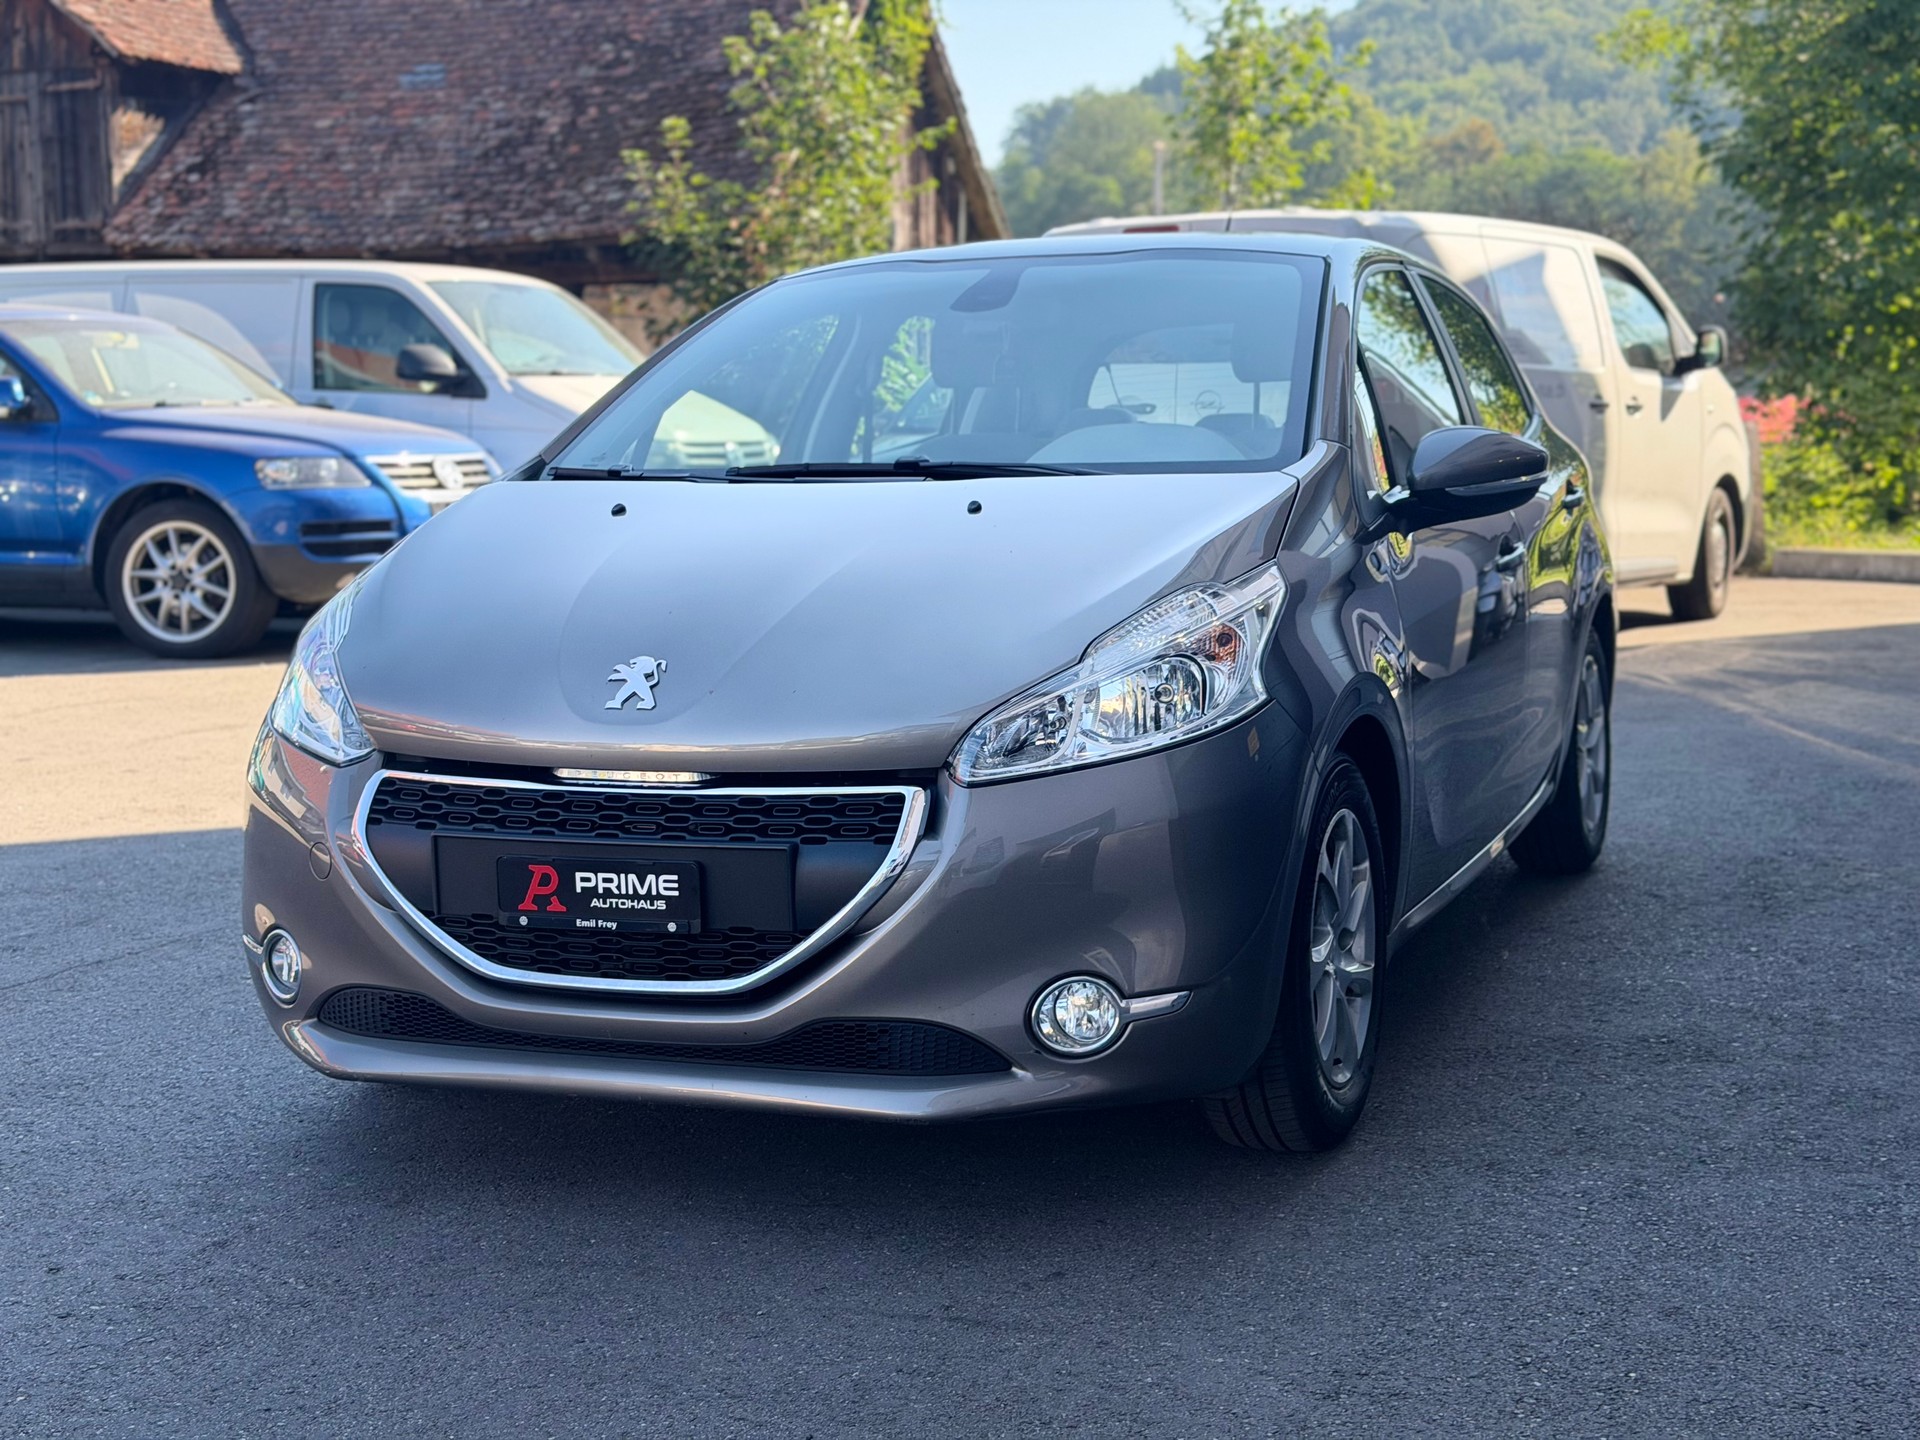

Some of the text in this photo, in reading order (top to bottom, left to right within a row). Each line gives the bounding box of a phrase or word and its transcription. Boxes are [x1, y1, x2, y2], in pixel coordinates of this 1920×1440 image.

[575, 871, 680, 896] PRIME
[590, 898, 667, 910] AUTOHAUS
[576, 919, 617, 930] Emil Frey
